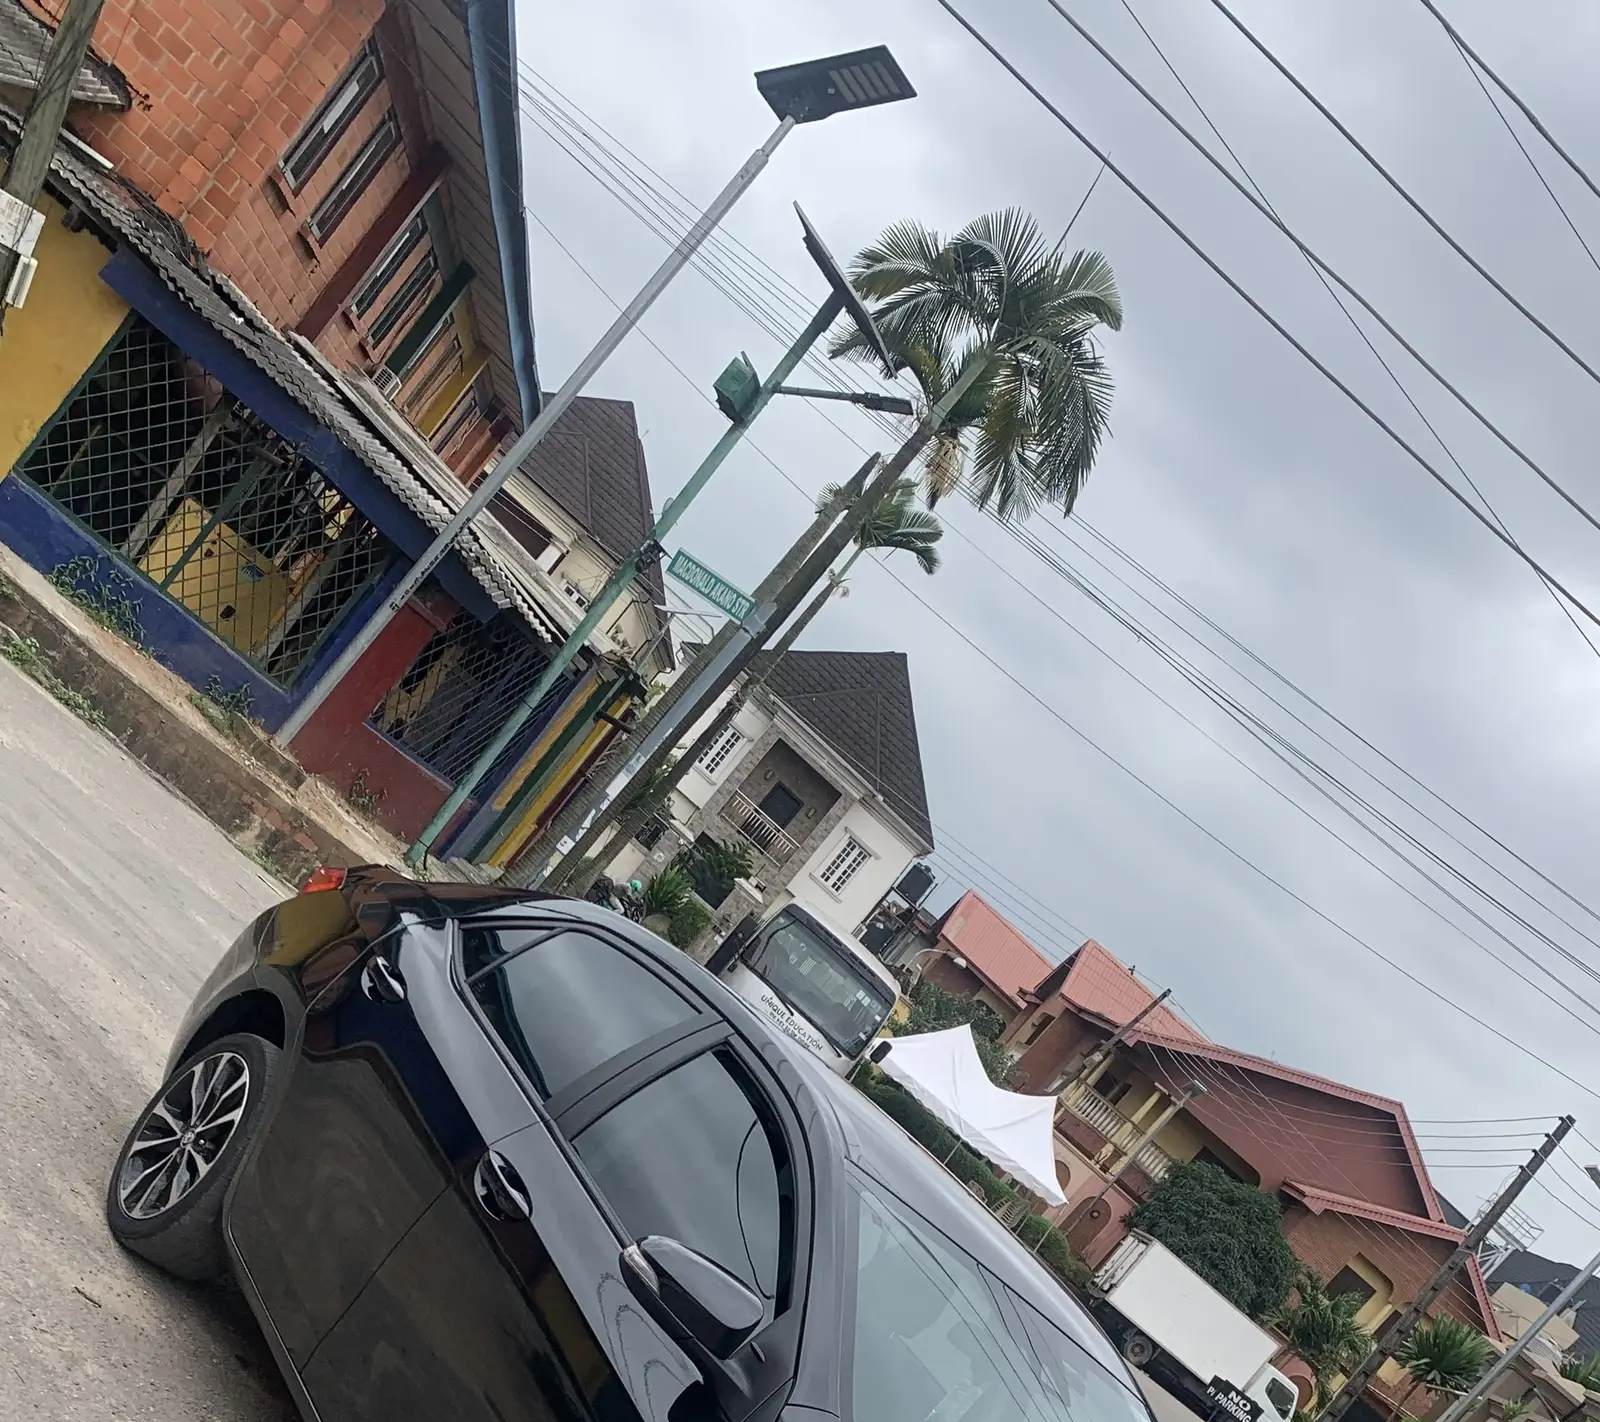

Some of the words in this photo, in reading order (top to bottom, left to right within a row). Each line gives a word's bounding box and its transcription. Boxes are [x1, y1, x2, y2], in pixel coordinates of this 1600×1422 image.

[672, 555, 716, 595] MACDONALD
[709, 582, 737, 610] AKANO
[731, 596, 750, 619] STR
[761, 994, 786, 1019] UNIQUE
[785, 1016, 824, 1051] EDUCATION
[1227, 1390, 1251, 1411] NO
